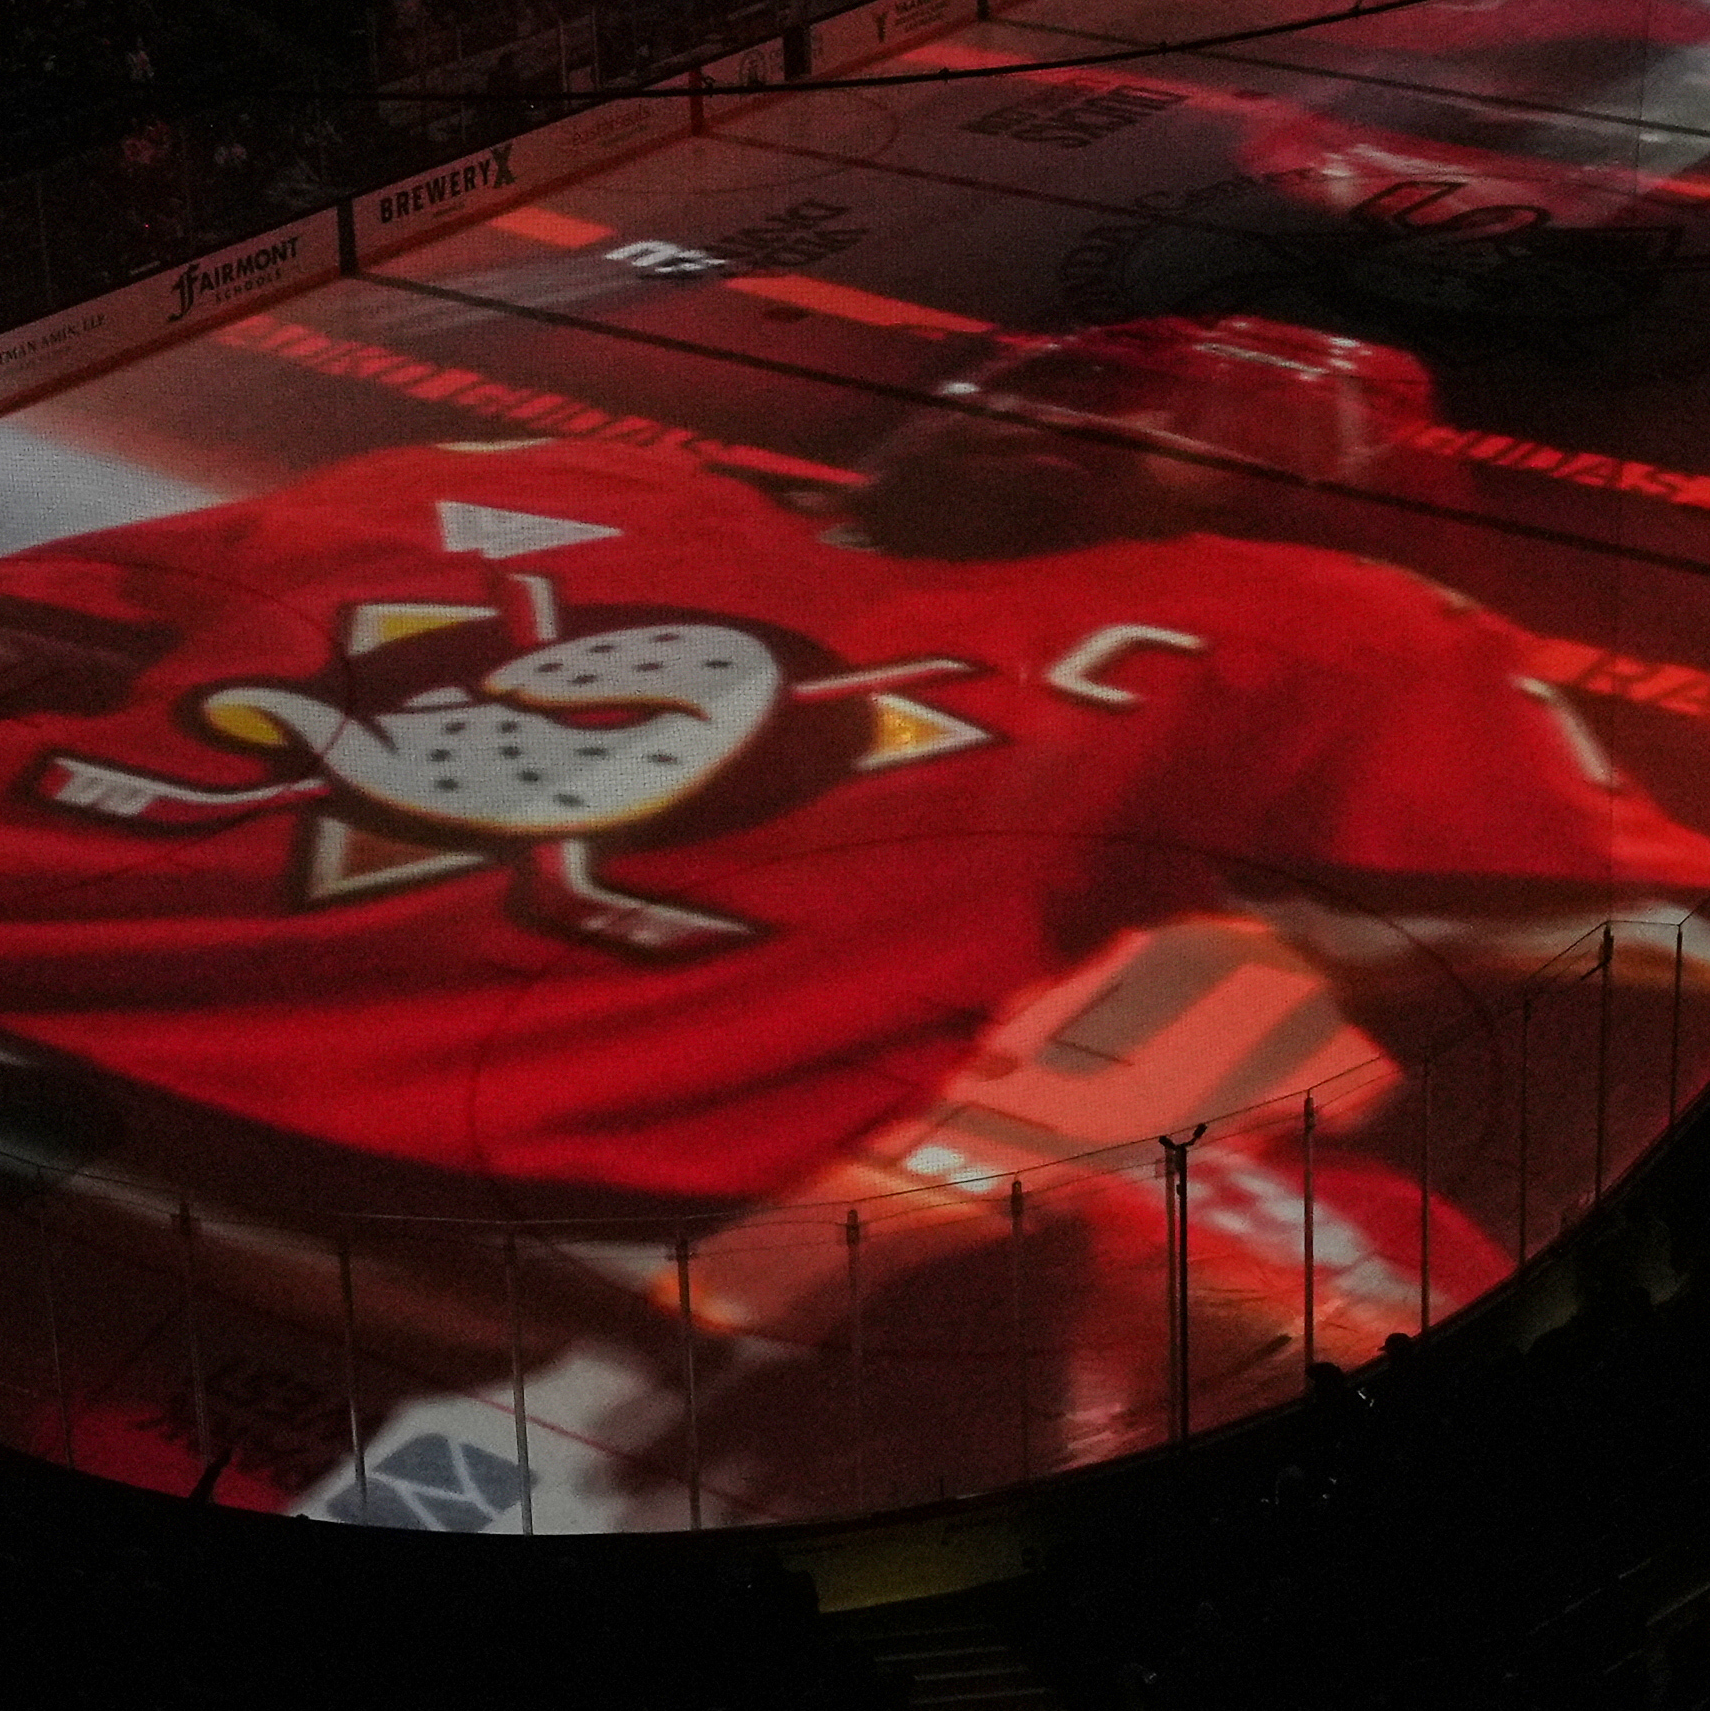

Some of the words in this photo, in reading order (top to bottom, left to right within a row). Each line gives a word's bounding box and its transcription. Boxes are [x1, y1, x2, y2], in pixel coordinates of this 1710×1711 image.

[168, 236, 300, 322] FAIRMONT
[213, 268, 283, 305] SCHOOLS
[82, 313, 106, 333] LLP
[1046, 623, 1203, 702] C
